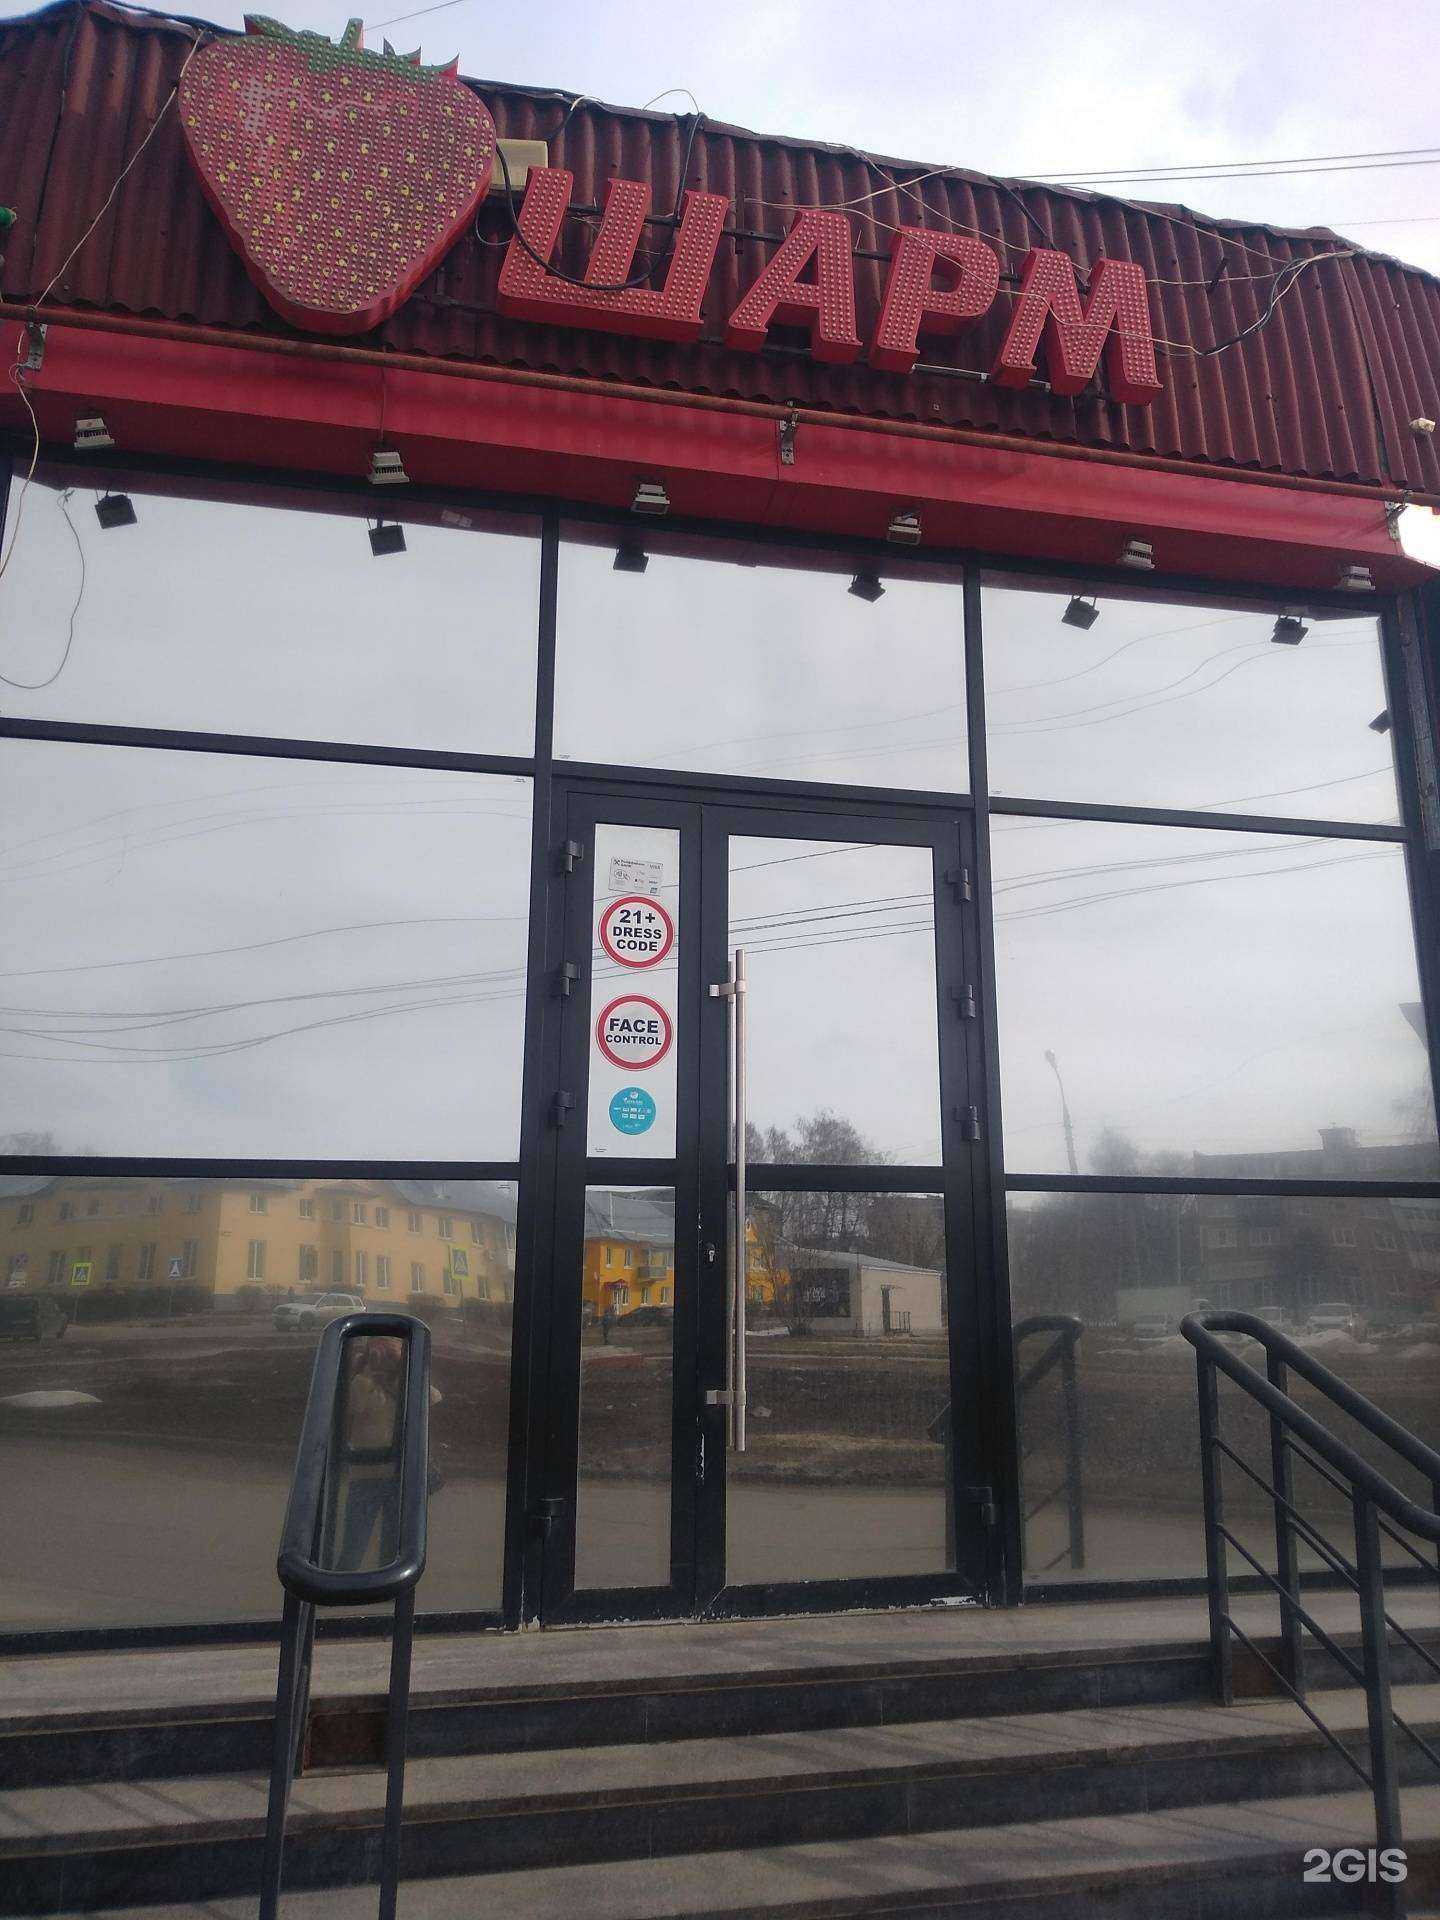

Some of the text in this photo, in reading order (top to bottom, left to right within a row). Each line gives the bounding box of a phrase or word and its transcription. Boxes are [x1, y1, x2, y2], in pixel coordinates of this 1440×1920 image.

[497, 166, 1164, 392] ШАРМ
[619, 909, 656, 924] 21+
[612, 926, 662, 939] DRESS
[616, 939, 658, 952] CODE
[609, 1017, 659, 1034] FACE
[605, 1034, 662, 1045] CONTROL
